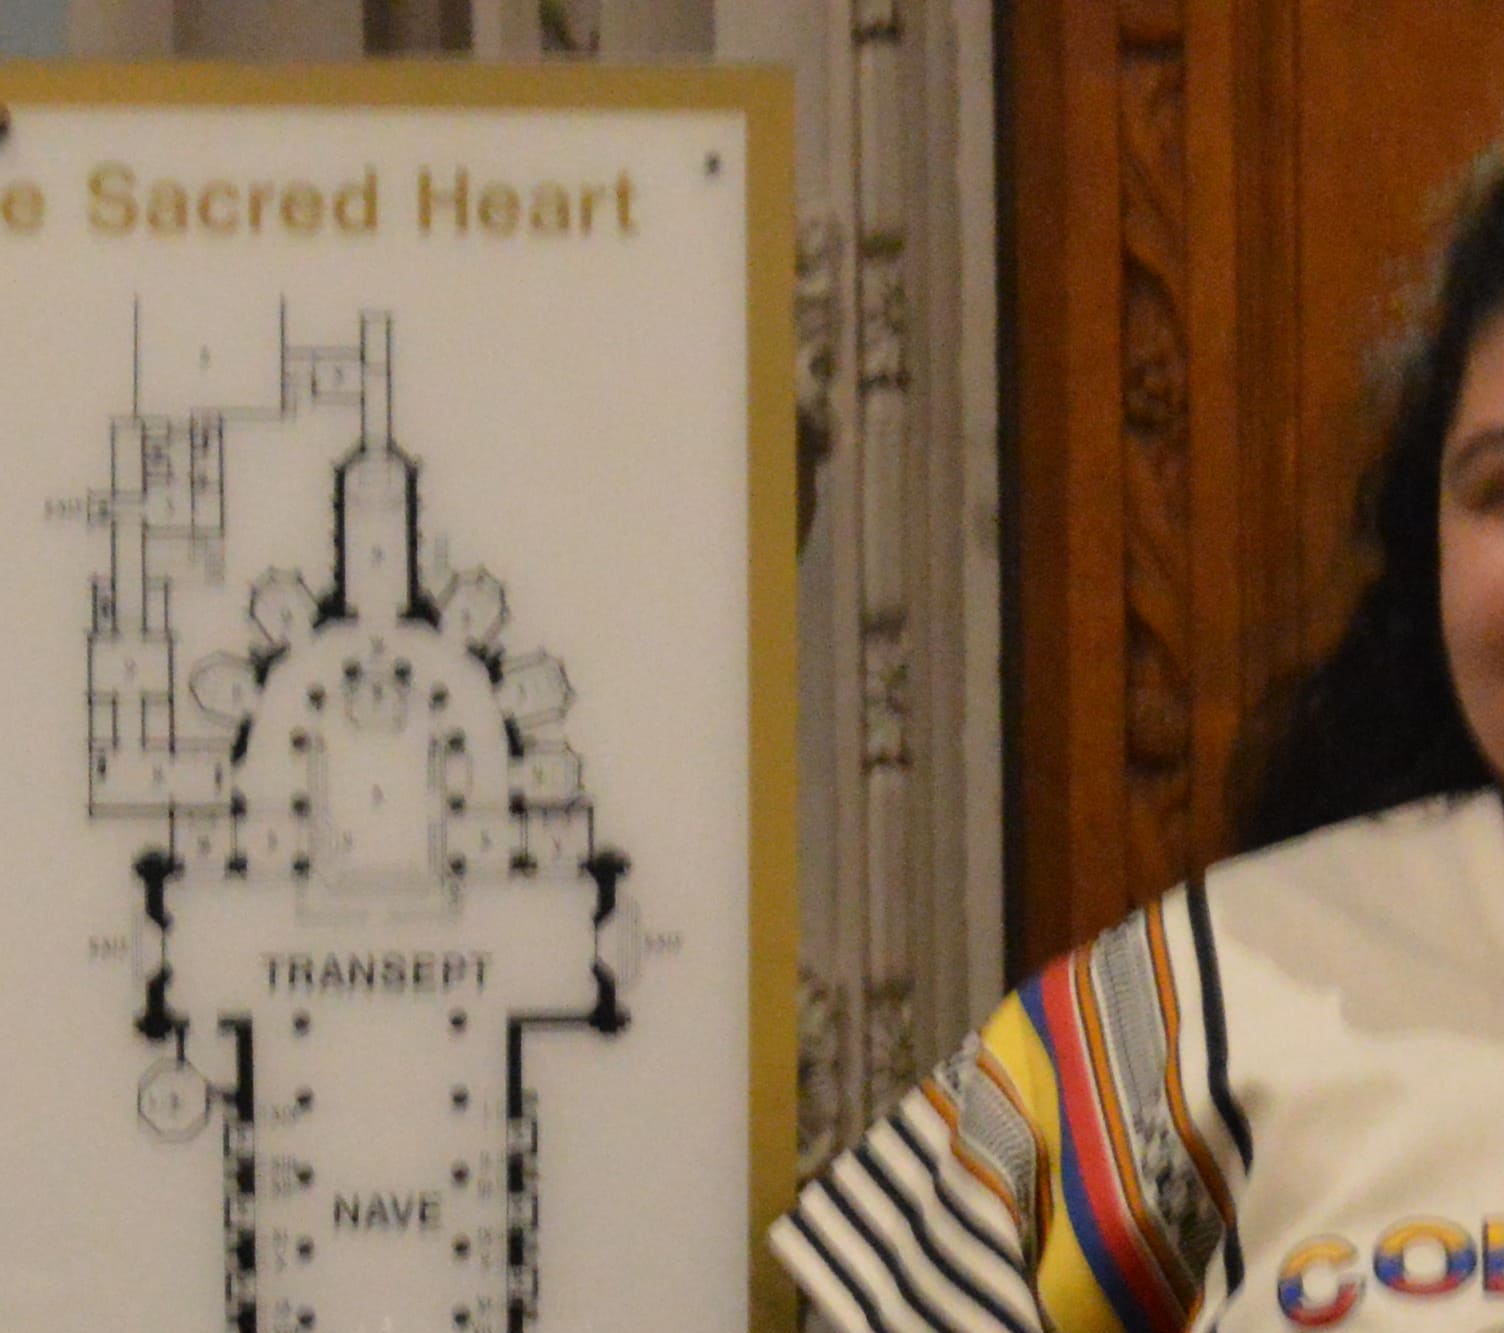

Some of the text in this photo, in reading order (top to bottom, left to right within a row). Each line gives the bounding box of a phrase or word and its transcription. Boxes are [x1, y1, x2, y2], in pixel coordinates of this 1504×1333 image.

[87, 160, 379, 238] Sacred
[416, 161, 637, 237] Heart
[262, 949, 494, 996] TRANSEPT
[330, 1187, 442, 1230] NAVE
